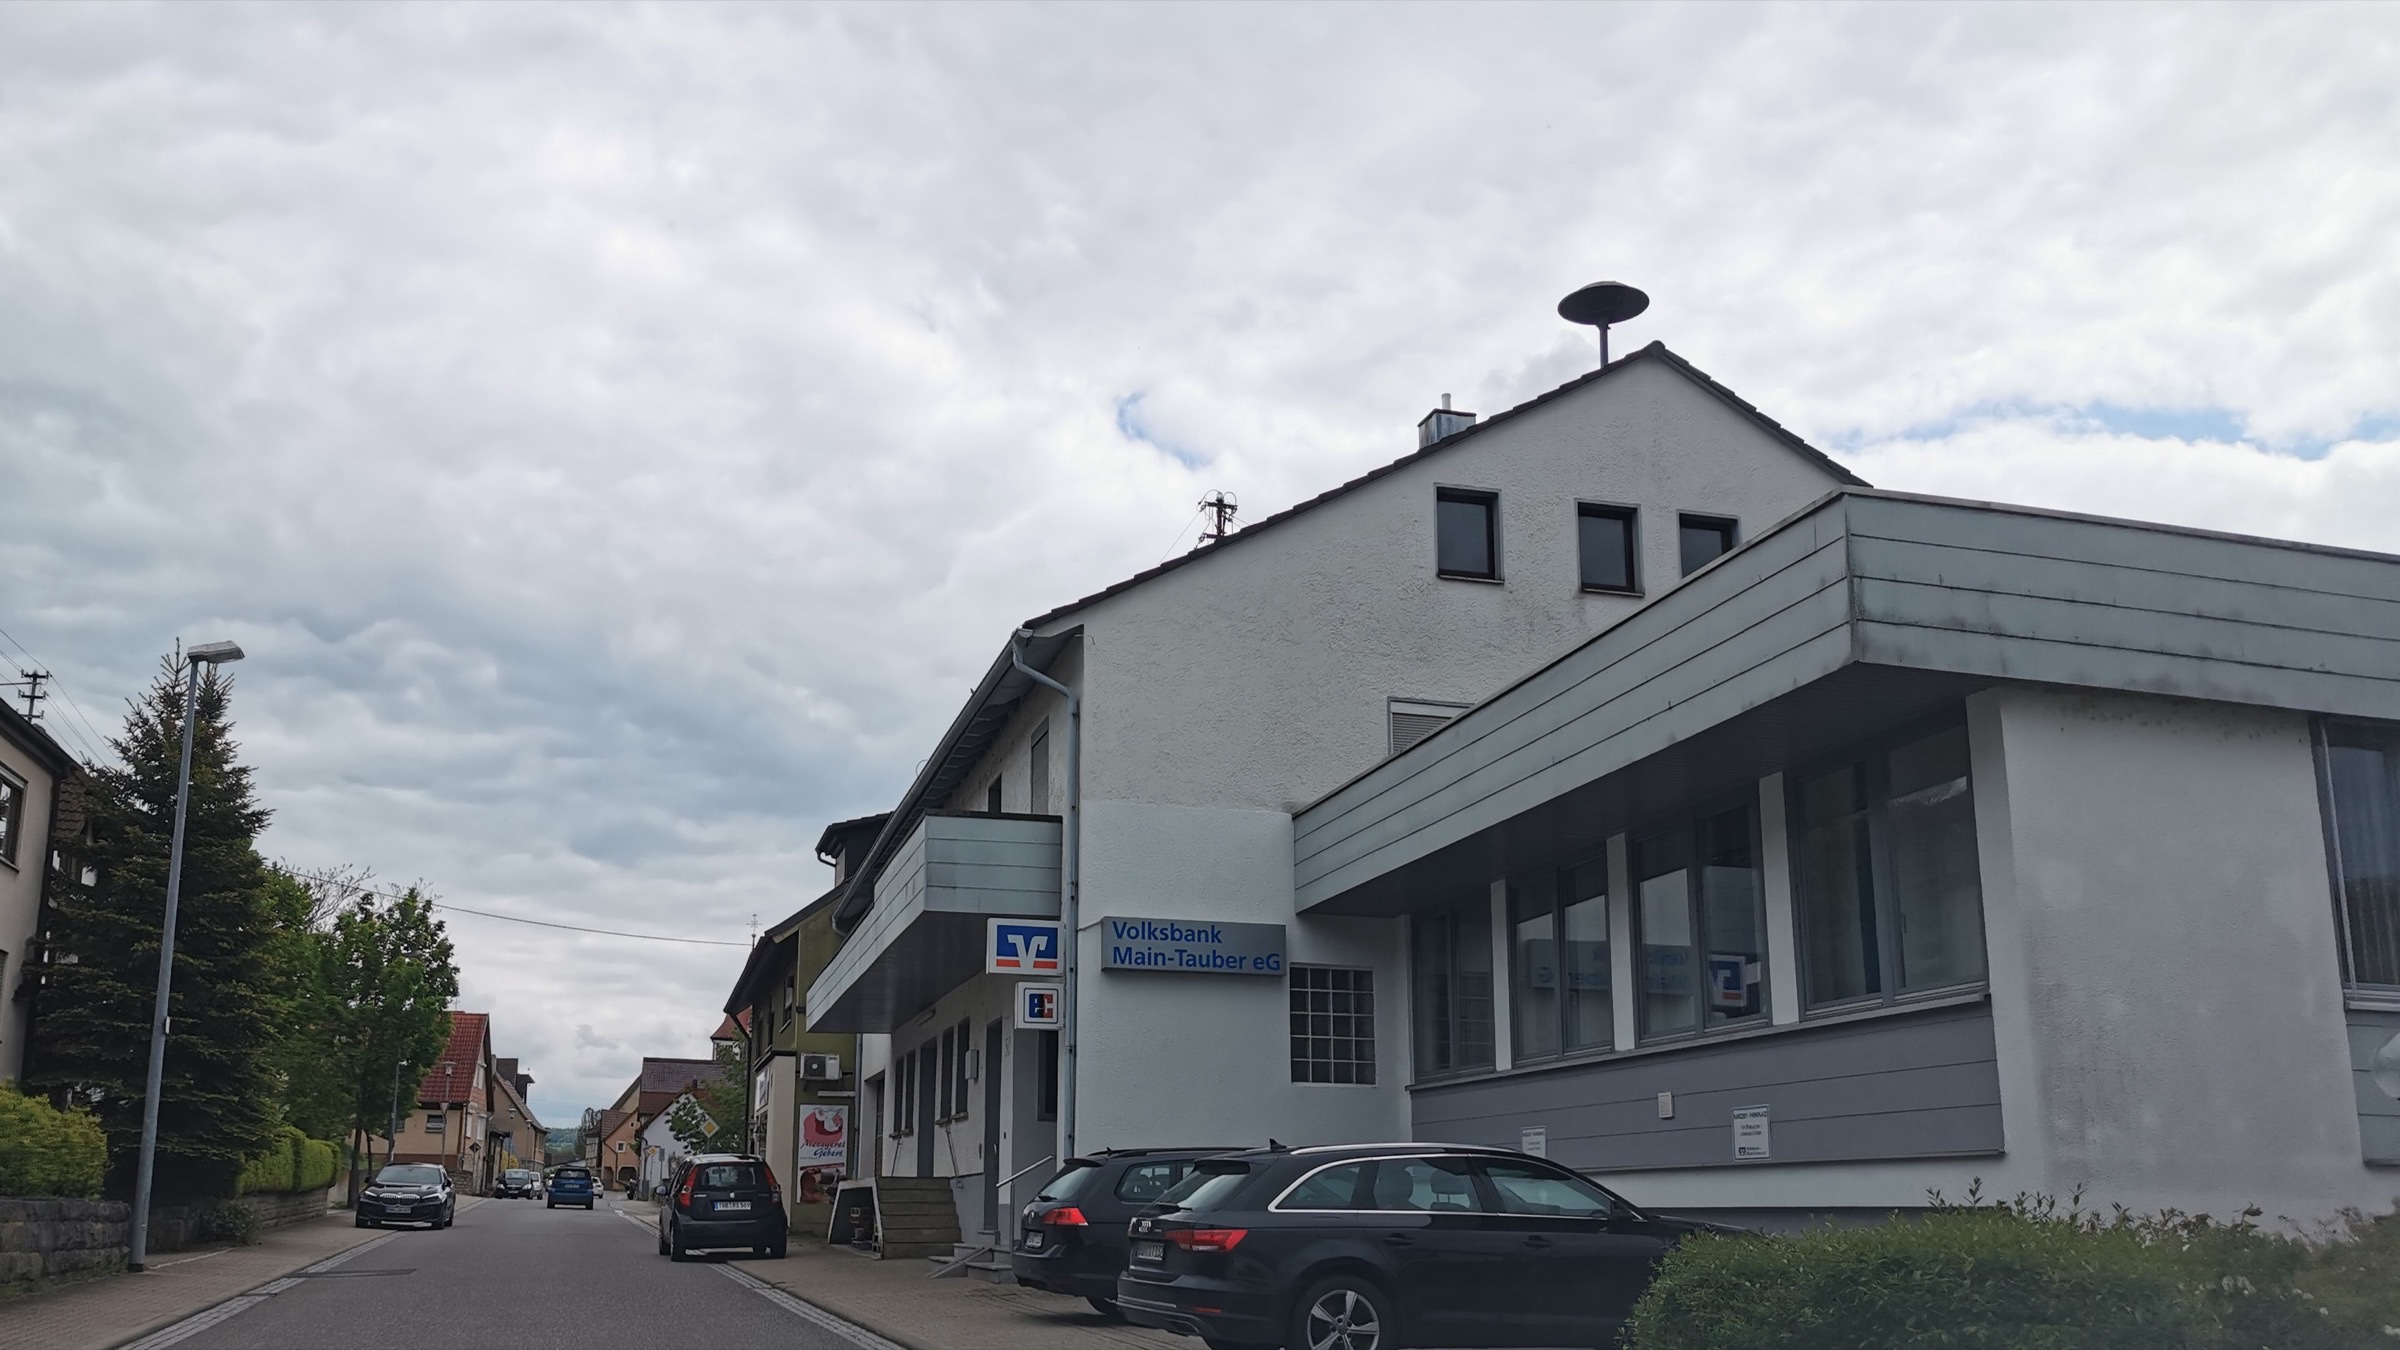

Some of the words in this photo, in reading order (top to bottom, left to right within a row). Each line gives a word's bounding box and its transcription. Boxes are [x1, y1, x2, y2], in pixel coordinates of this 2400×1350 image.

[1112, 920, 1223, 944] Volksbank
[1112, 946, 1247, 970] Main-Tauber
[1253, 953, 1281, 971] eG
